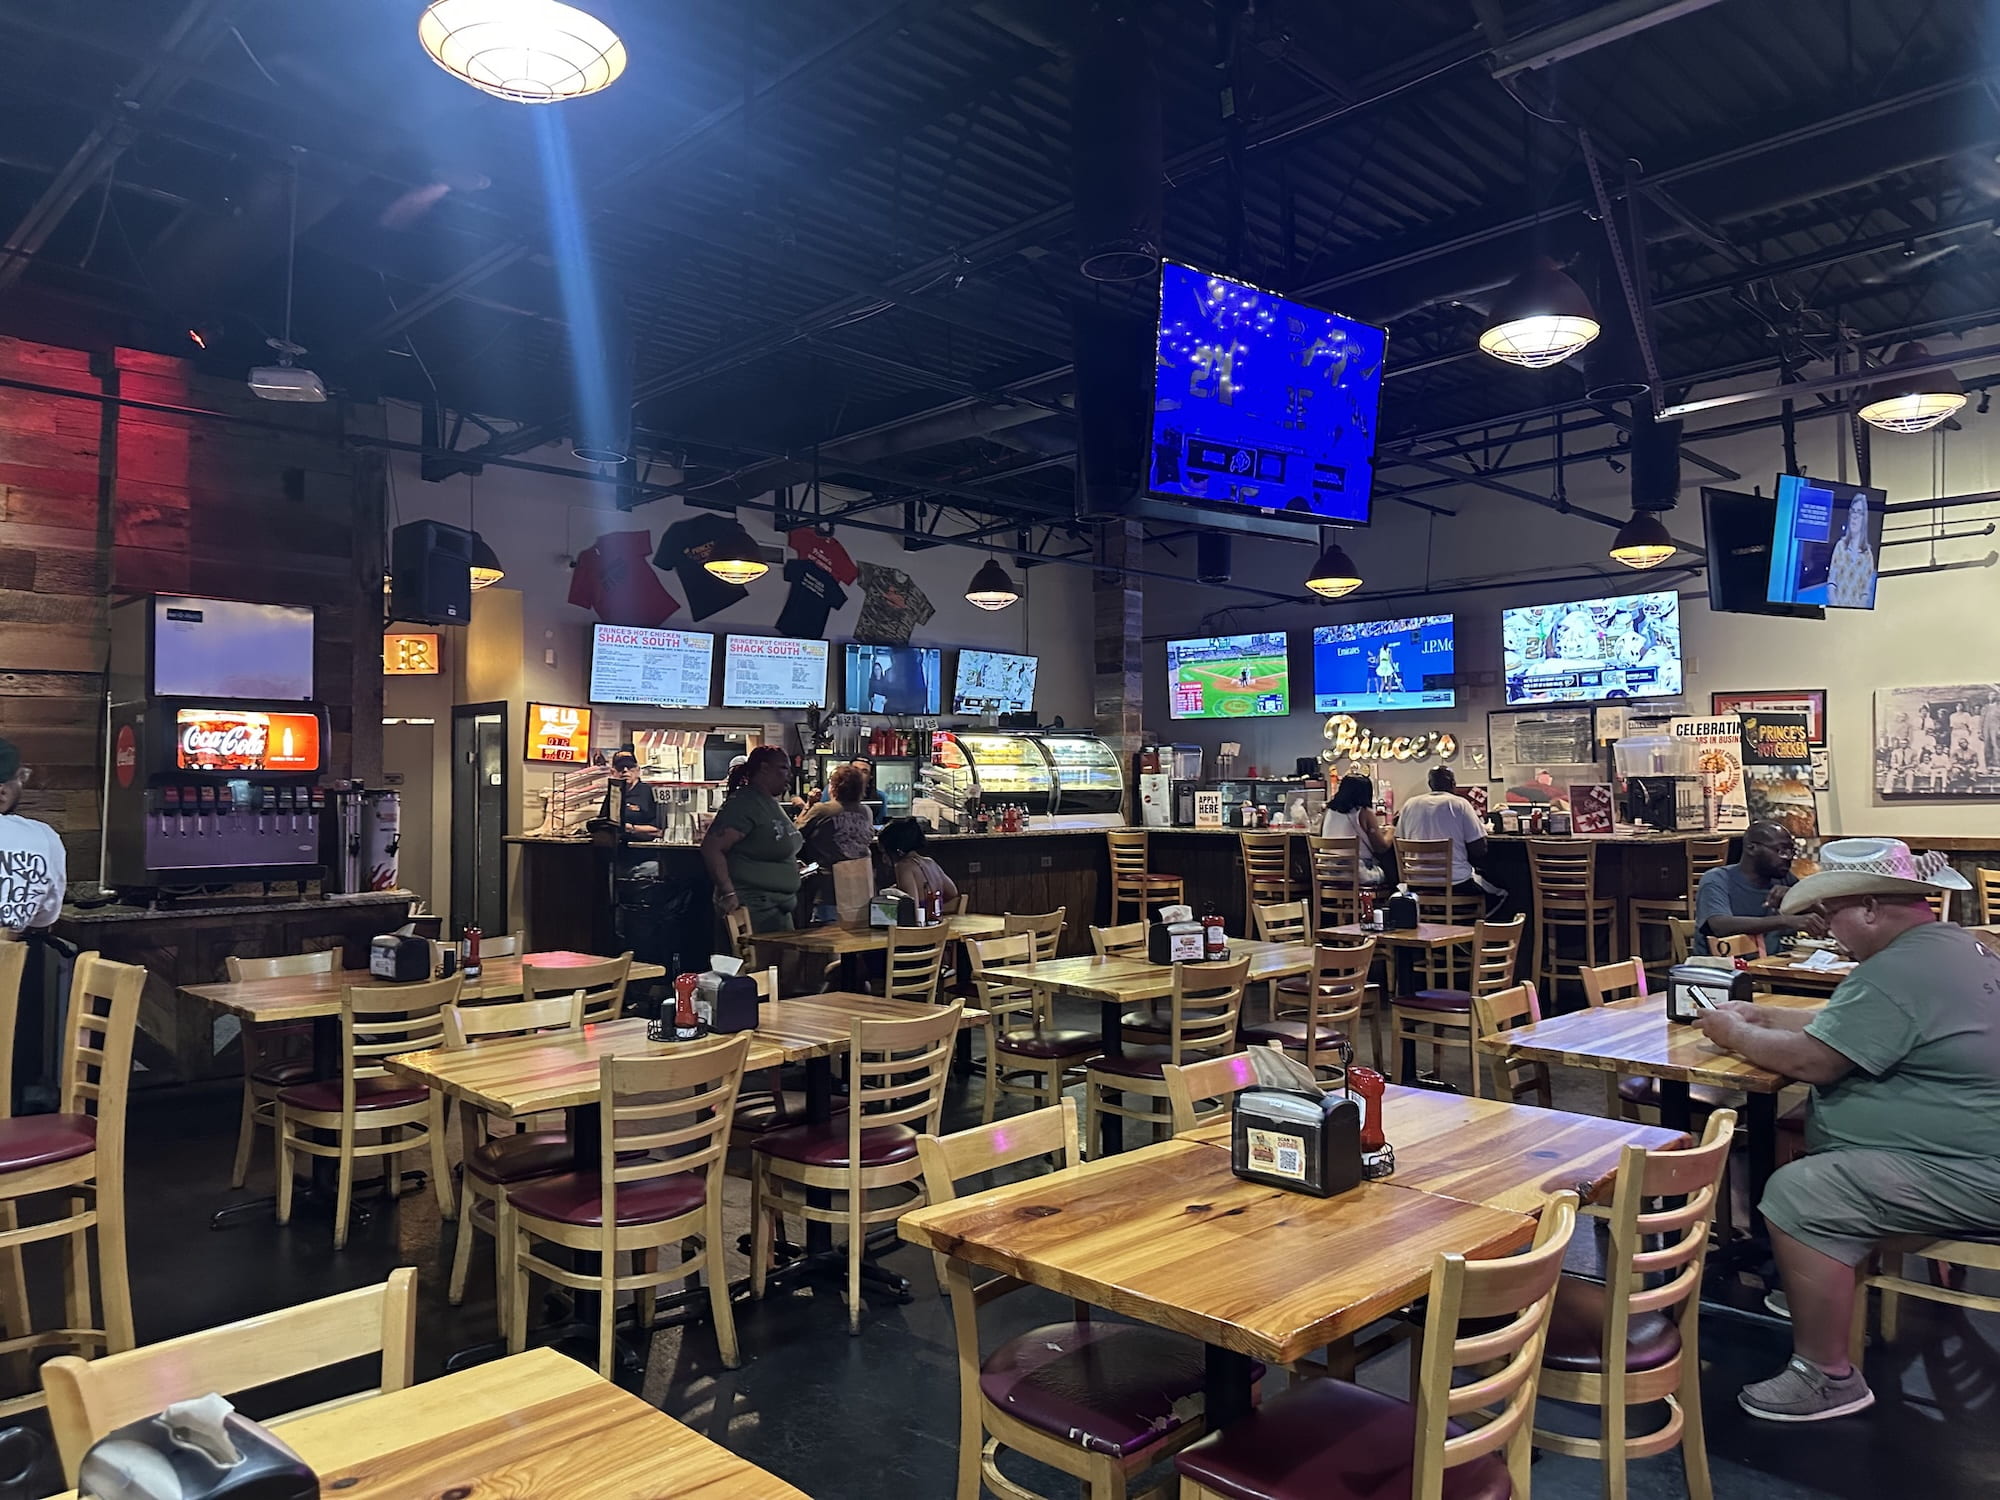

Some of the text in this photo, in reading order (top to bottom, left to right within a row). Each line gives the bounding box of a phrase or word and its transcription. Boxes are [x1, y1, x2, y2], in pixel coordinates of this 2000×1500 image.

[598, 633, 638, 645] SHACK
[642, 637, 680, 648] SOUTH
[650, 631, 681, 639] CHICKEN
[729, 643, 764, 654] SHACK
[767, 646, 800, 656] SOUTH
[183, 724, 266, 756] Coca-Cola
[1322, 714, 1457, 762] Prince's
[1759, 725, 1807, 742] PRINCE'S
[1199, 795, 1218, 804] APPLY
[1199, 803, 1219, 814] HERE
